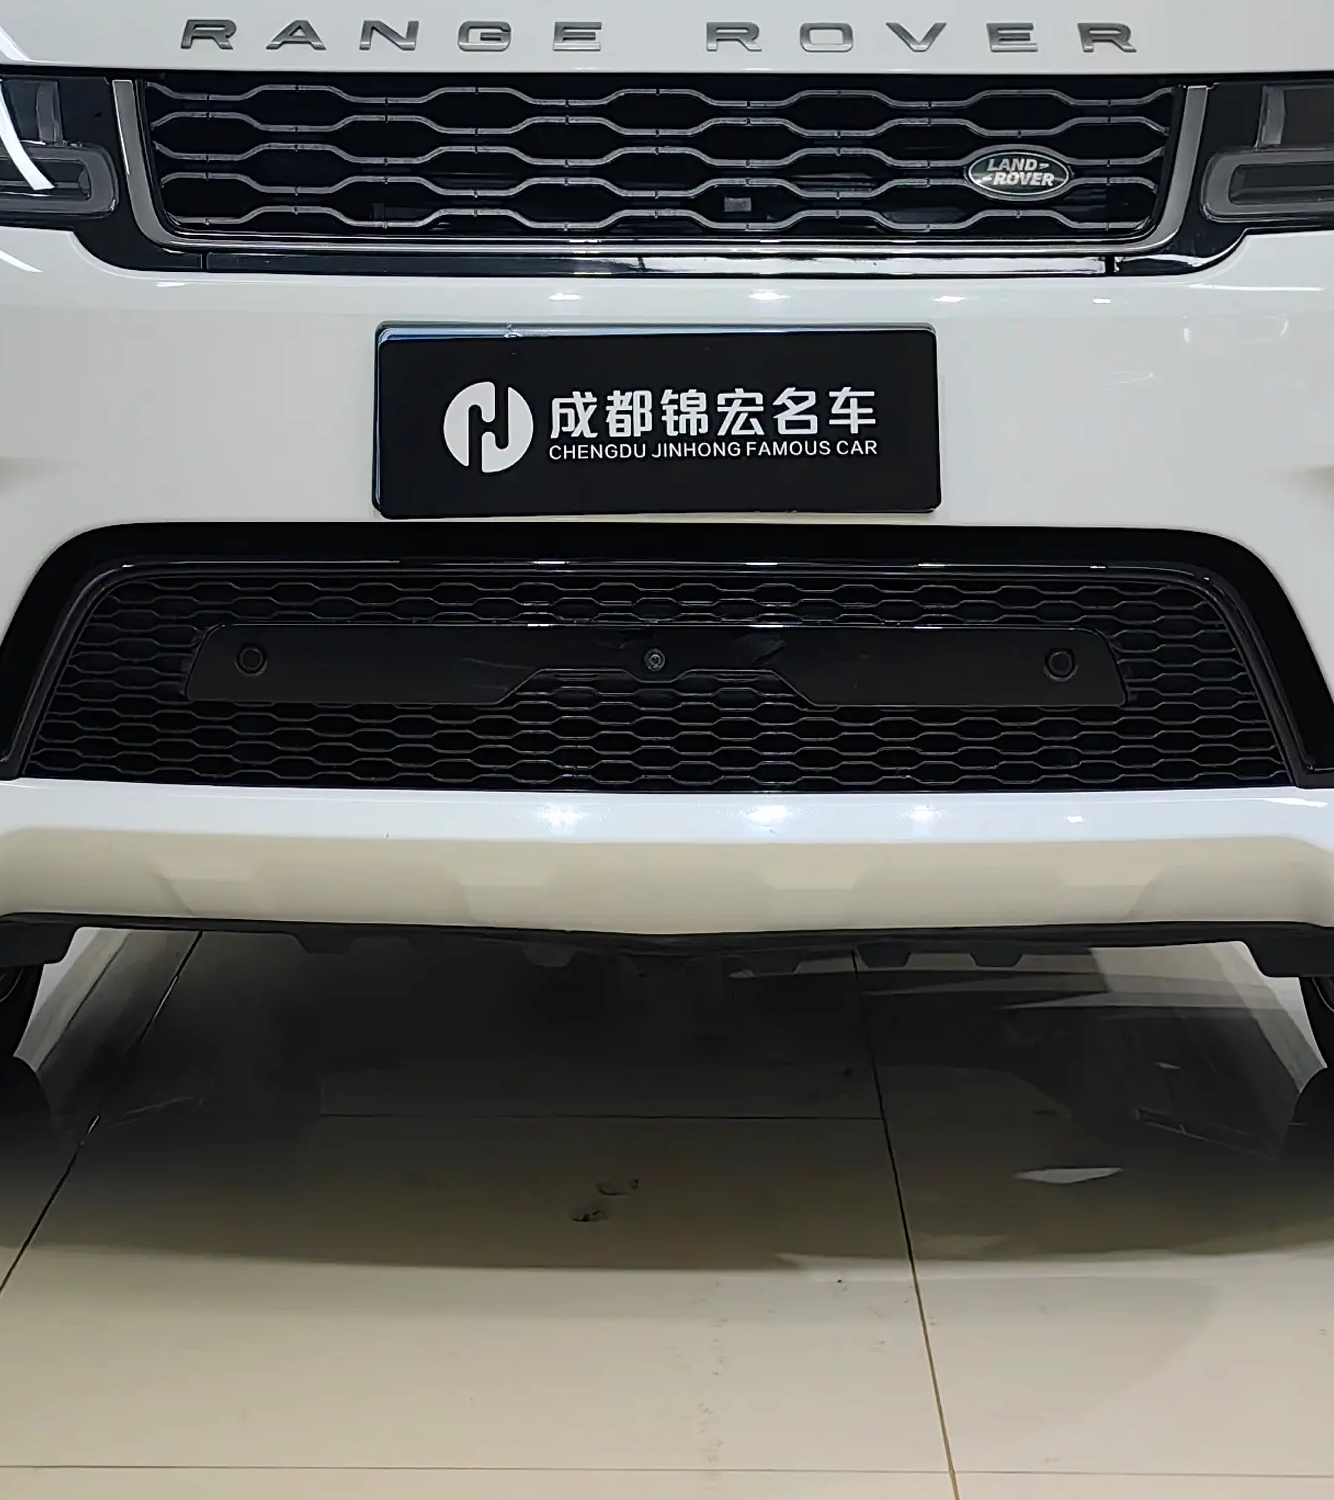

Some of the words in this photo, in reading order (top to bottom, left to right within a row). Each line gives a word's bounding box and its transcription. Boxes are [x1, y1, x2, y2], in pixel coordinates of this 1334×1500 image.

[180, 18, 603, 52] RANGE
[705, 21, 1137, 53] ROVER
[987, 158, 1038, 171] LAND
[993, 171, 1056, 186] ROVER
[550, 387, 876, 439] 成都锦宏名车
[548, 443, 646, 460] CHENGDU
[651, 442, 741, 458] JINHONG
[746, 440, 830, 457] FAMOUS
[835, 440, 878, 455] CAR
